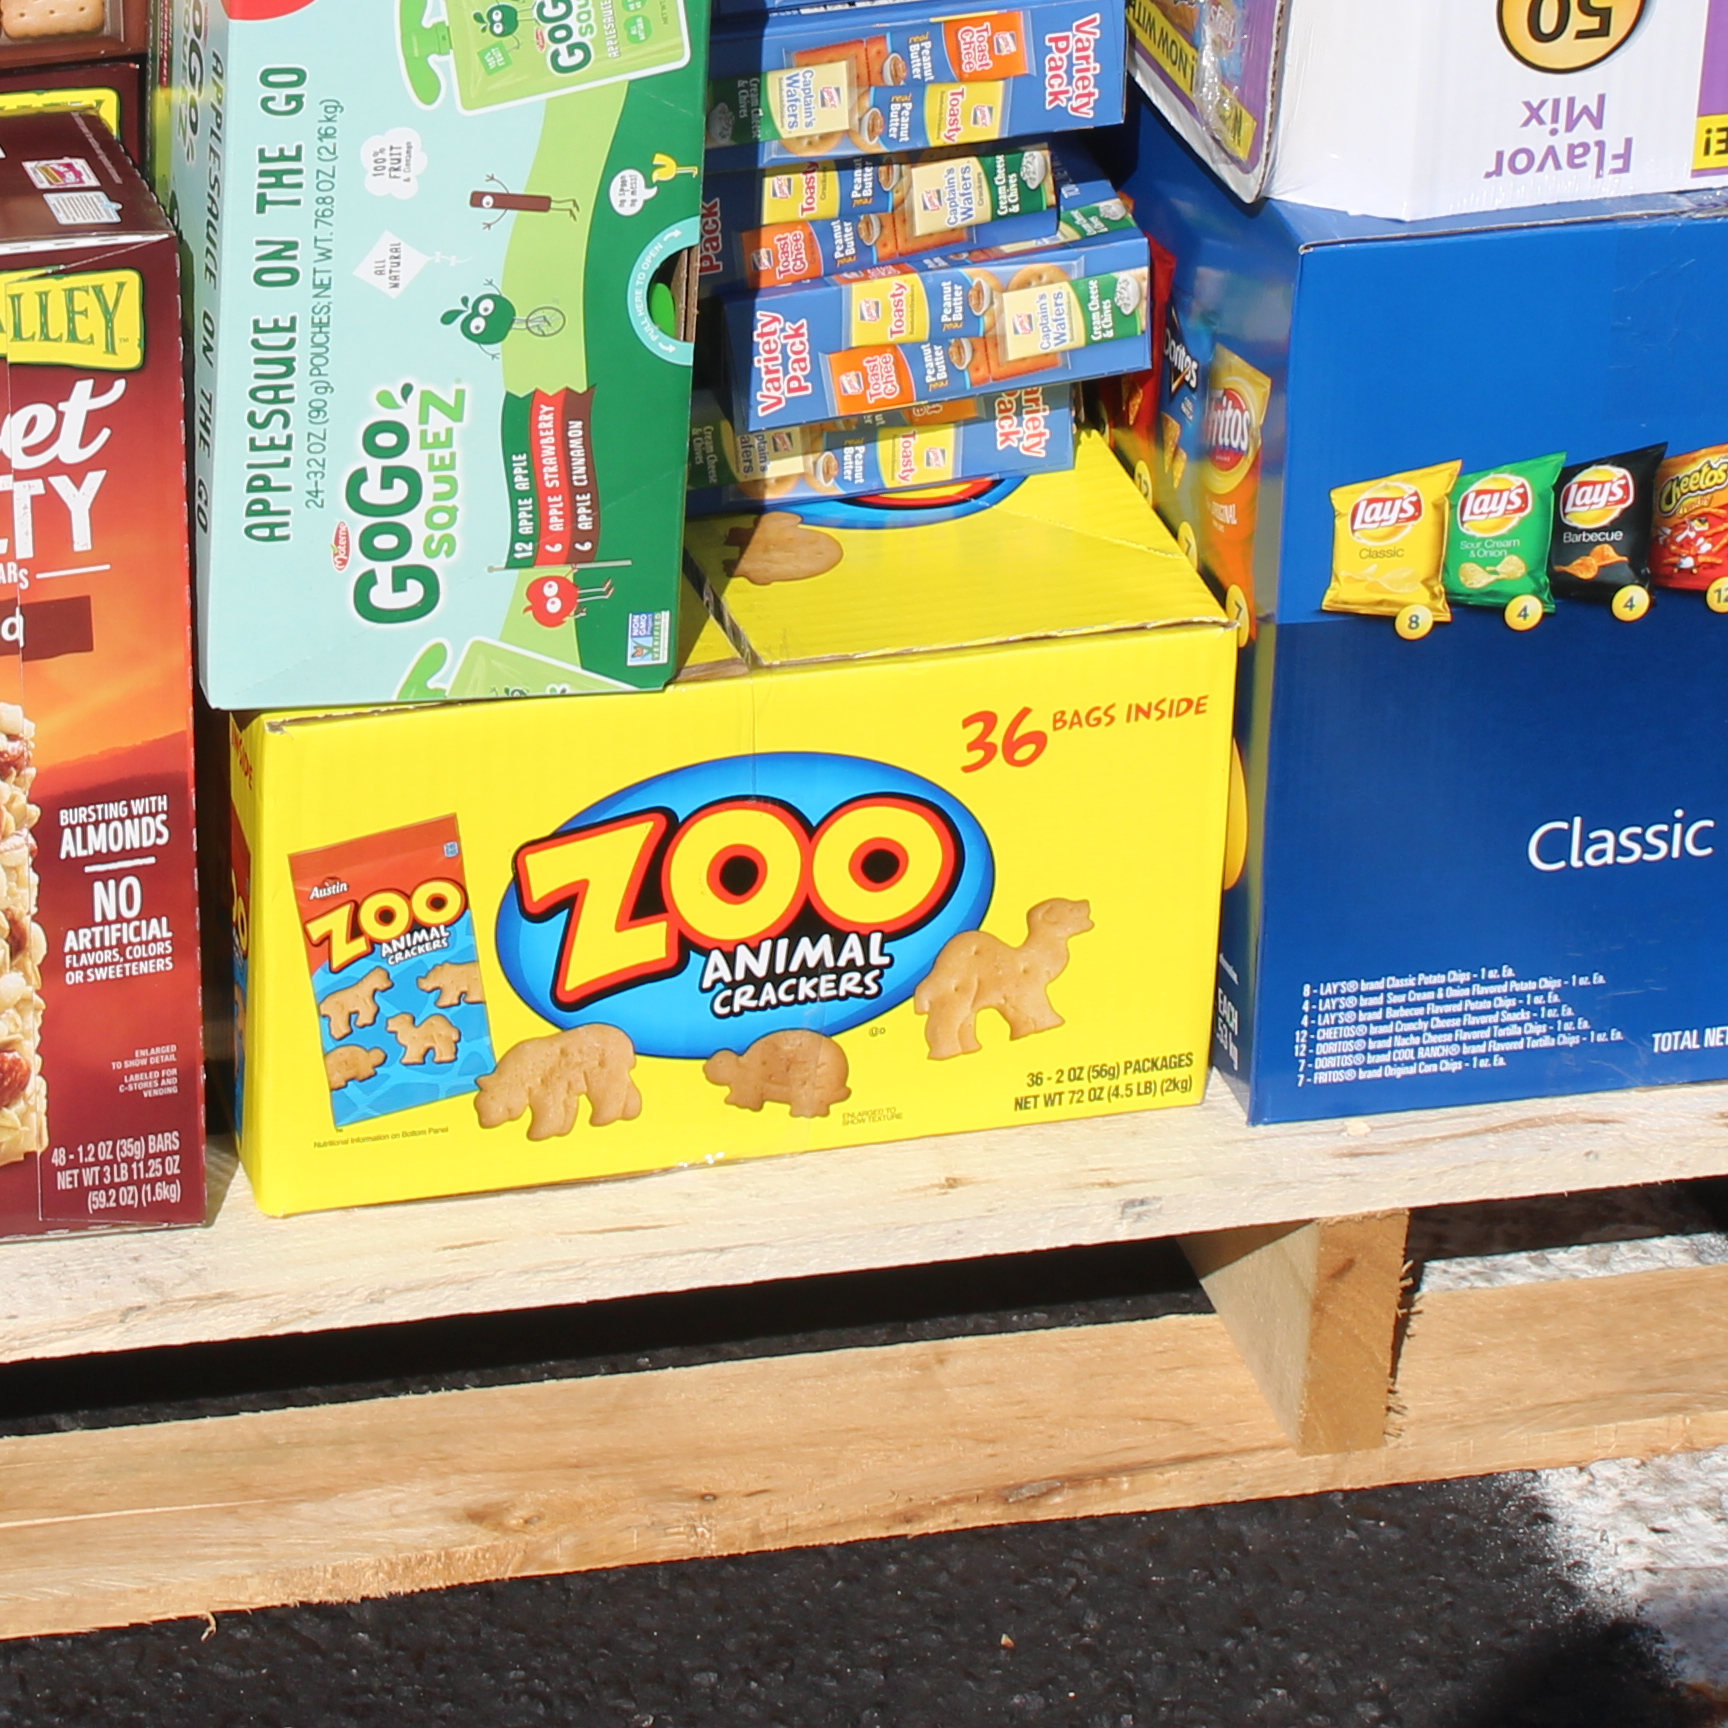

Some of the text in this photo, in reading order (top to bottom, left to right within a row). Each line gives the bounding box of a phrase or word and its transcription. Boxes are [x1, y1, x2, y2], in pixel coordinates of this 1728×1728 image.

[1520, 93, 1606, 136] Mix
[1484, 138, 1633, 179] Flavor
[244, 65, 307, 542] APPLESAUCE ON THE GO
[538, 404, 560, 488] STRAWBERRY
[512, 452, 534, 560] 12 APPLE APPLE
[1352, 495, 1420, 533] Lay's
[1459, 484, 1529, 524] Lay's
[1561, 476, 1631, 514] Lay's
[1562, 527, 1623, 543] Barbecue
[961, 694, 1209, 776] 36 BAGS INSIDE
[60, 795, 168, 826] BURSTING WITH
[59, 816, 169, 860] ALMONDS
[1527, 810, 1715, 873] Classic
[93, 876, 142, 922] NO
[309, 881, 348, 901] Austin
[513, 794, 963, 1010] ZOO
[64, 917, 172, 952] ARTIFICIAL
[305, 878, 468, 973] ZOO
[380, 925, 449, 957] ANIMAL
[387, 937, 448, 967] CRACKERS
[701, 931, 892, 989] ANIMAL
[711, 970, 881, 1019] CRACKERS
